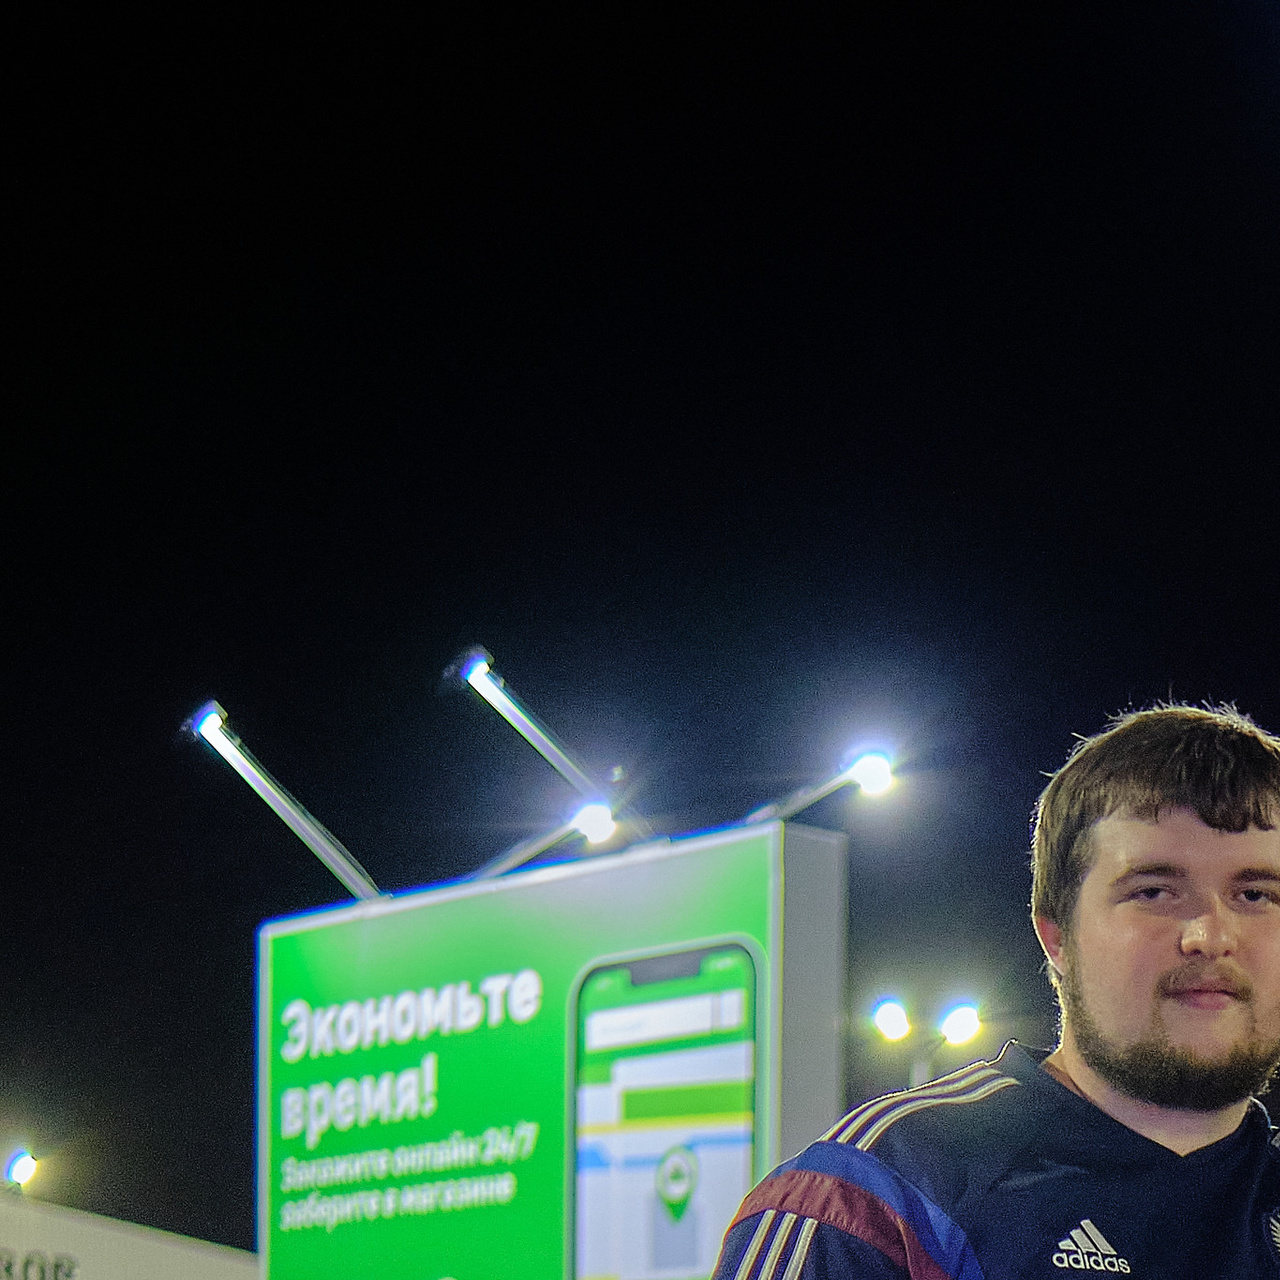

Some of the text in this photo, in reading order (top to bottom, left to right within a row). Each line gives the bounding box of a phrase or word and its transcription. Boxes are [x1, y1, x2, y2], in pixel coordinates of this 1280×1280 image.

[282, 969, 541, 1062] Экономьте
[281, 1052, 438, 1149] время!
[482, 1120, 539, 1163] 24/7
[1052, 1248, 1131, 1273] adidas
